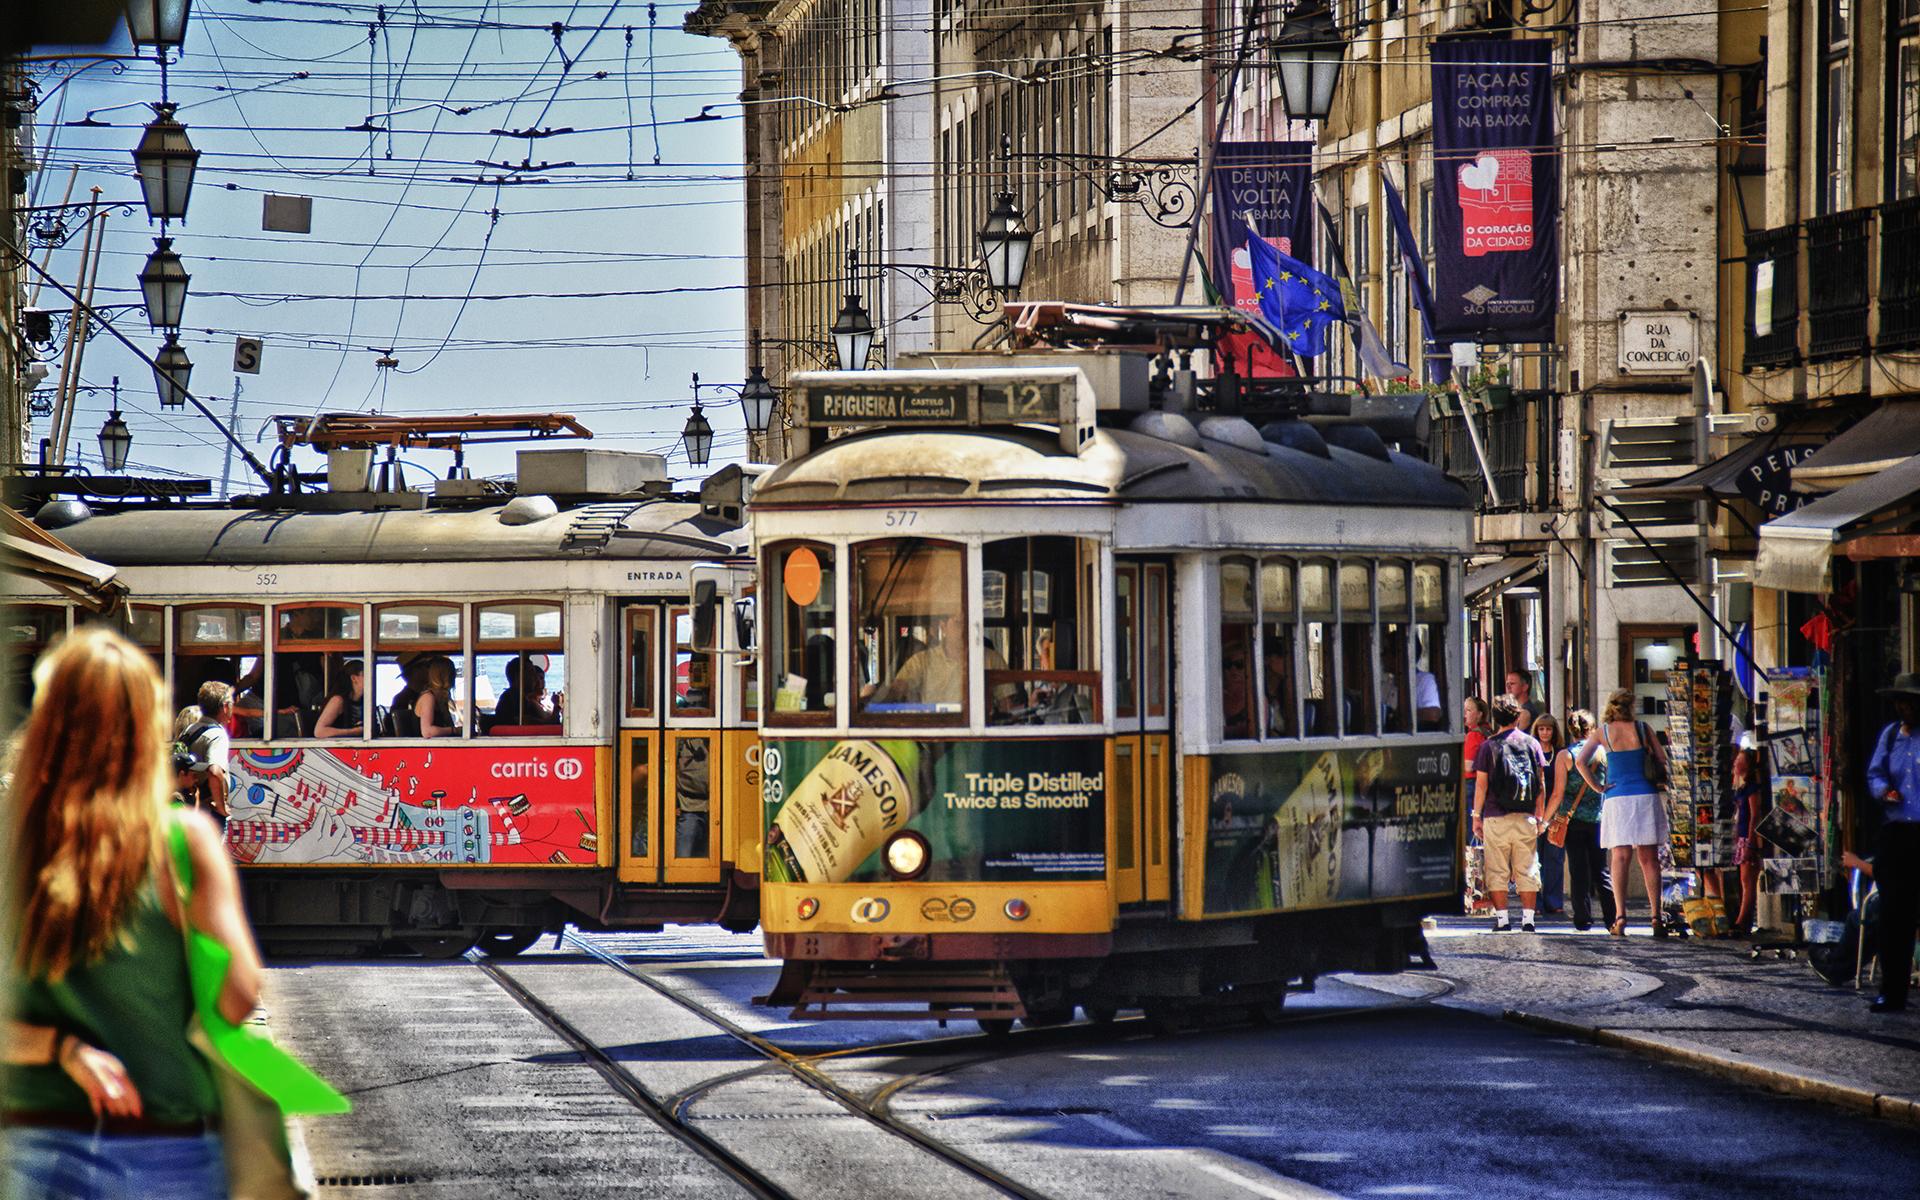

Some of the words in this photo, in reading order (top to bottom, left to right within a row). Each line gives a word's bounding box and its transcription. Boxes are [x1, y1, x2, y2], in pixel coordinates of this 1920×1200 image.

[1457, 72, 1504, 91] FAÇA
[1507, 72, 1529, 87] AS
[1457, 94, 1530, 109] COMPRAS
[1458, 115, 1481, 128] NA
[1485, 113, 1531, 127] BAIXA
[1231, 168, 1252, 184] DÊ
[1256, 170, 1291, 184] UMA
[1231, 188, 1291, 205] VOLTA
[1254, 209, 1291, 220] BAIXA
[1465, 226, 1475, 235] O
[1477, 224, 1532, 235] CORAÇÃO
[1466, 238, 1484, 248] DA
[1486, 235, 1532, 248] CIDADE
[1463, 304, 1485, 315] SÃO
[1487, 304, 1535, 313] NICOLAU
[1646, 324, 1671, 336] RUA
[1650, 338, 1666, 349] DA
[237, 342, 258, 369] S
[1626, 349, 1691, 363] CONCEIÇÃO
[910, 398, 944, 406] CASTELO
[1002, 384, 1042, 417] 12
[885, 510, 918, 527] 577
[256, 573, 277, 586] 552
[627, 571, 683, 581] ENTRADA
[490, 757, 548, 778] carris
[1416, 751, 1438, 774] carris
[827, 746, 899, 831] JAMESON
[964, 772, 1025, 797] Triple
[1028, 771, 1104, 793] Distilled
[943, 793, 998, 809] Twice
[1000, 796, 1021, 808] as
[1395, 784, 1420, 817] Triple
[1421, 783, 1457, 813] Distilled
